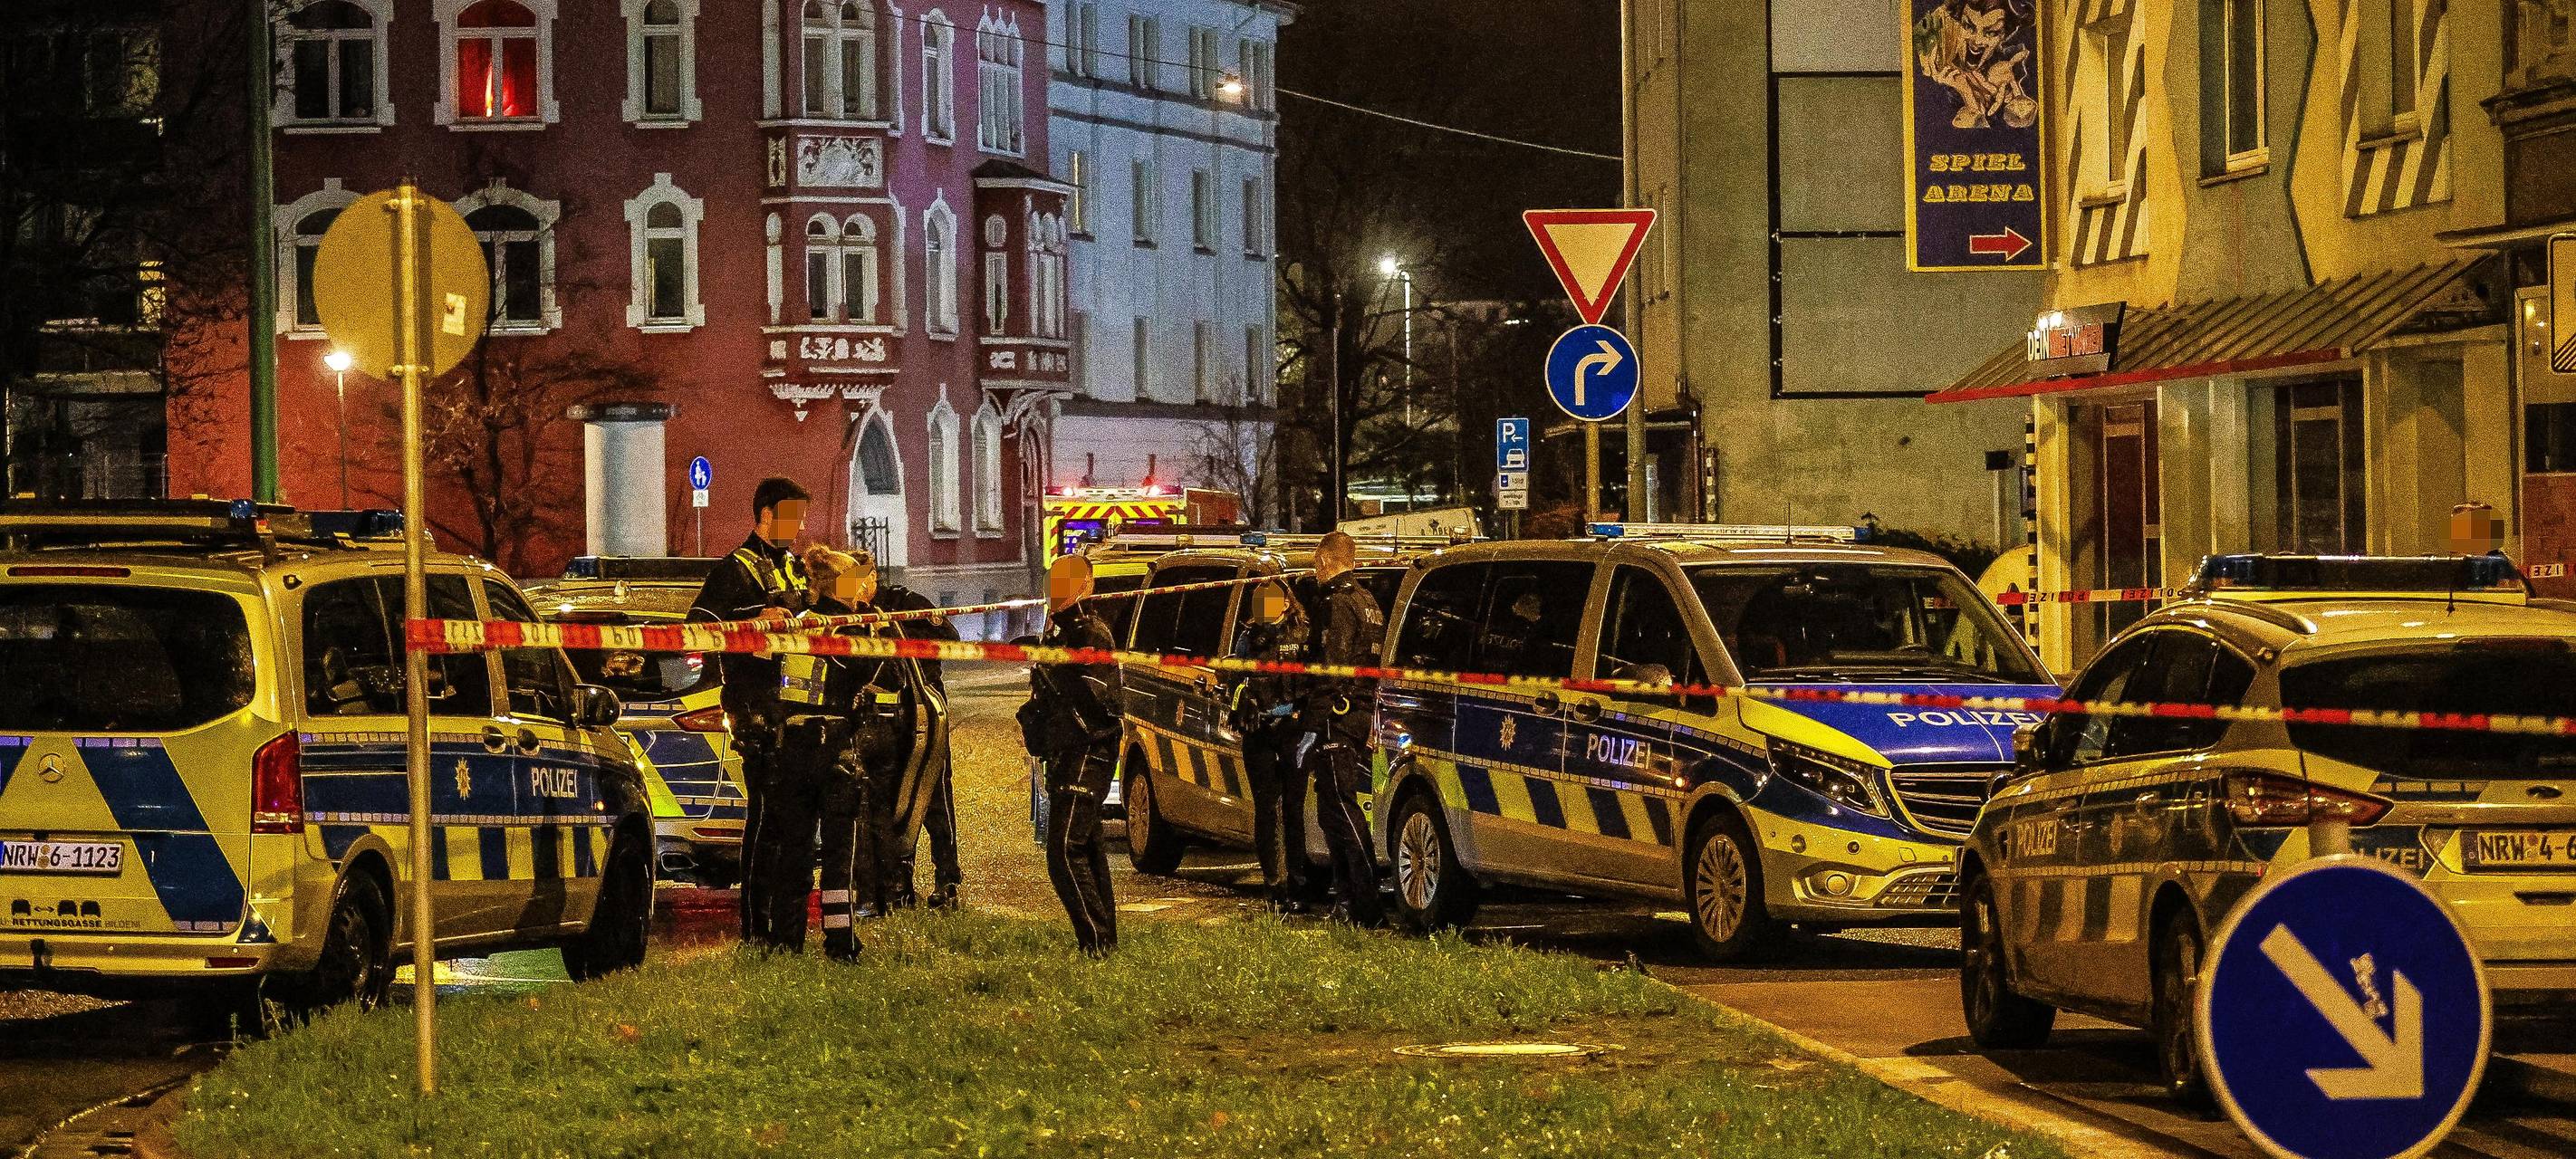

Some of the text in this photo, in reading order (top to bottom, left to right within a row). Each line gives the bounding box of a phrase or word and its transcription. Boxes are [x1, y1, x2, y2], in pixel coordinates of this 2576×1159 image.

[1929, 153, 2026, 172] SPIEL
[1923, 184, 2035, 203] ARENA
[1503, 422, 1516, 443] P
[1887, 711, 2050, 727] POLIZEI
[1586, 733, 1651, 770] POLIZEI
[531, 767, 579, 798] POLIZEI
[2016, 820, 2057, 857] POLIZEI
[2479, 835, 2524, 860] NRW
[1, 844, 120, 867] NRW 6-1123
[12, 918, 102, 928] RETTUNGSGASSE
